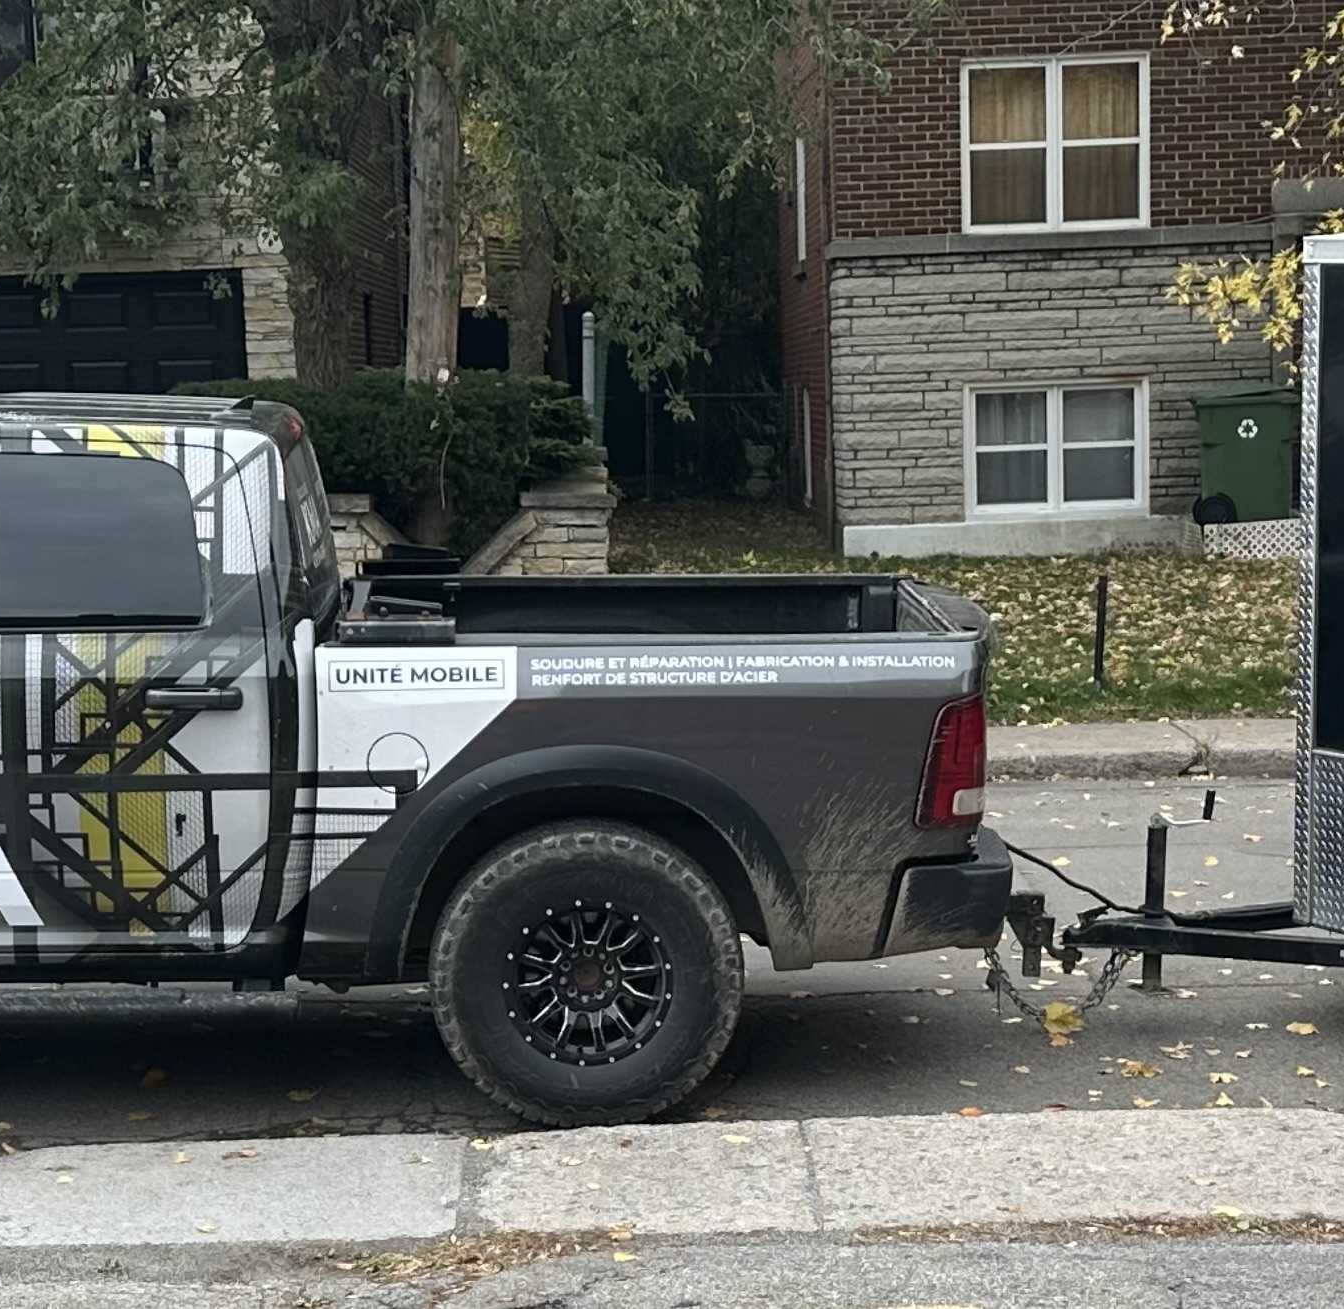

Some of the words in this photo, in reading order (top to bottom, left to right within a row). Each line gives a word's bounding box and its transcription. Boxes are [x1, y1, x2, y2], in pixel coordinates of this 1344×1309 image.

[530, 657, 606, 671] SOUDURE
[608, 657, 627, 669] ET
[629, 654, 725, 669] RÉPARATION
[736, 655, 835, 668] FABRICATION
[838, 655, 850, 667] &
[852, 655, 956, 668] INSTALLATION
[335, 663, 404, 685] UNITÉ
[410, 666, 499, 684] MOBILE
[531, 673, 602, 687] RENFORT
[605, 673, 627, 685] DE
[629, 671, 717, 685] STRUCTURE
[720, 670, 779, 684] D'ACIER
